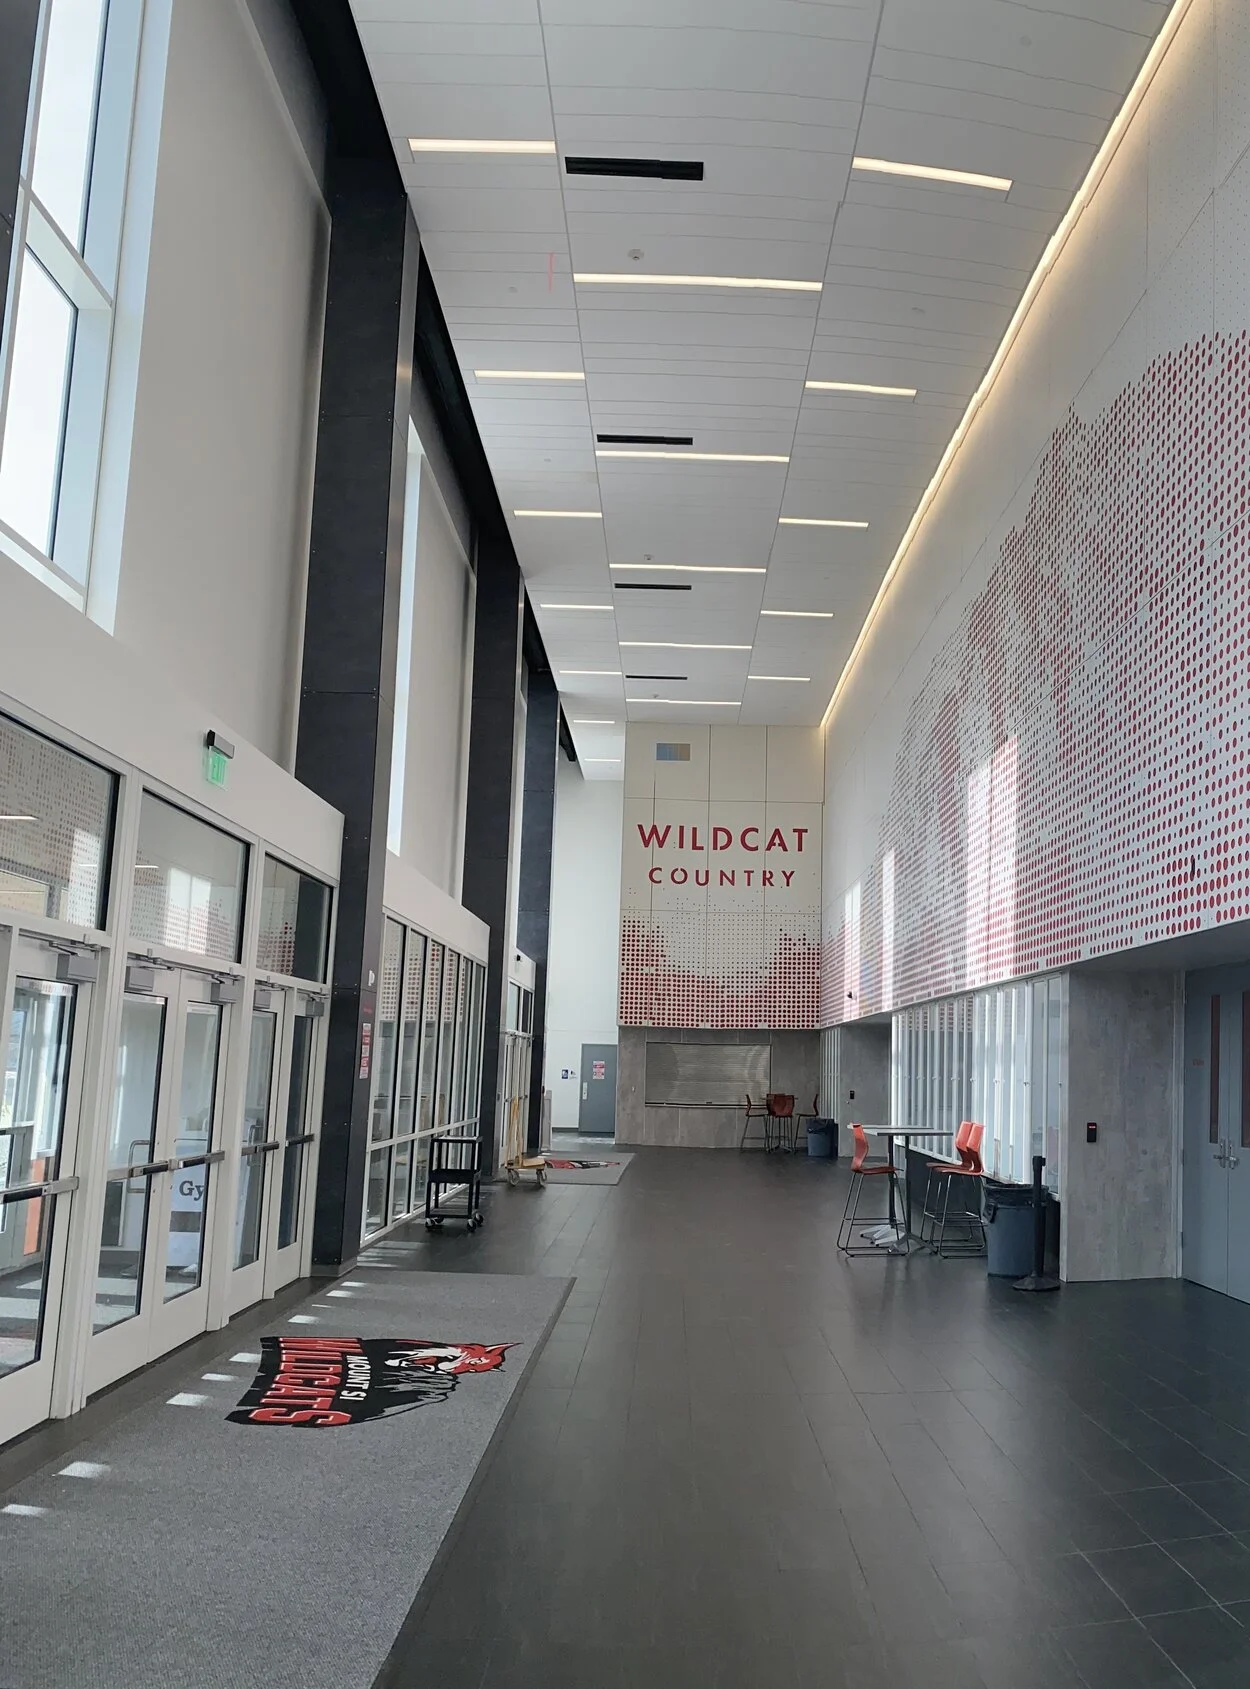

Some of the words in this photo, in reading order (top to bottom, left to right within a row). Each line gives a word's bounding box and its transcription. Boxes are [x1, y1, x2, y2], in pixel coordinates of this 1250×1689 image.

[637, 824, 808, 852] WILDCAT
[648, 867, 795, 887] COUNTRY
[248, 1337, 364, 1425] WILDCATS
[345, 1355, 372, 1390] MOUNT
[339, 1390, 367, 1401] SI
